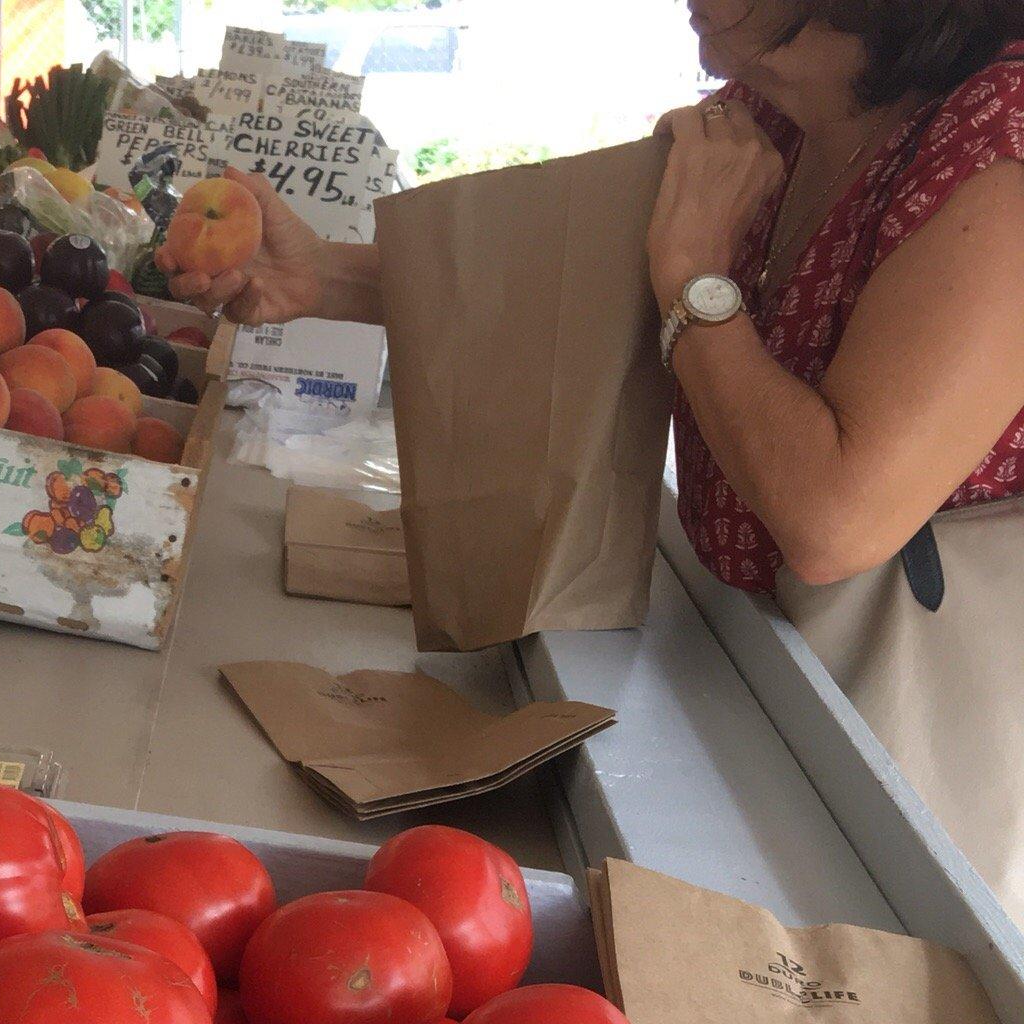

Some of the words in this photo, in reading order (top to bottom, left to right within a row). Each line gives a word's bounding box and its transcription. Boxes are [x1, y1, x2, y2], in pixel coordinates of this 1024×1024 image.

[239, 112, 283, 131] RED
[294, 120, 373, 145] SWEET
[233, 133, 360, 164] CHERRIES
[295, 377, 357, 401] NORDIC
[777, 952, 807, 976] 12
[810, 991, 860, 1001] LIFE
